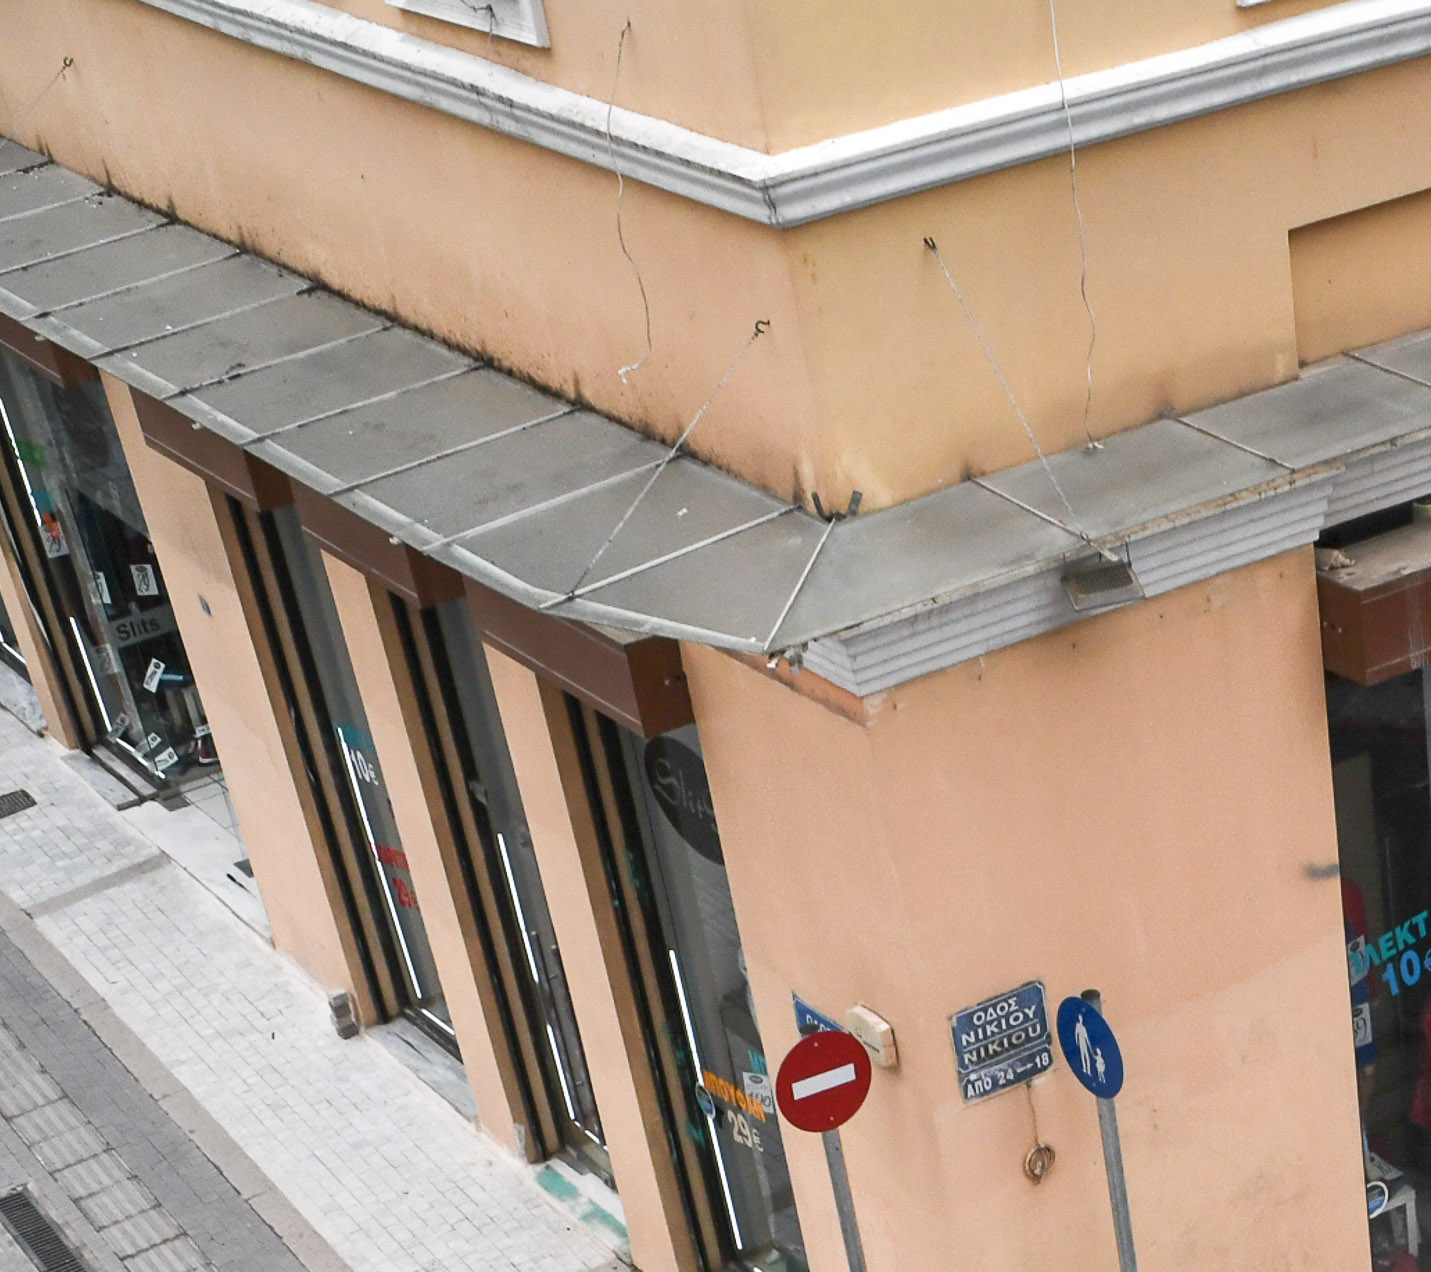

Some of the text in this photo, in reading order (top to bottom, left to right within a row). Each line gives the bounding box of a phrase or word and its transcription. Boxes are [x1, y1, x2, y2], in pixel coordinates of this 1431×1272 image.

[116, 617, 161, 641] Slits
[961, 1004, 1036, 1046] ΝΙΚΙΟΥ
[973, 996, 1019, 1025] ΟΔΟΣ
[964, 1023, 1041, 1064] NIKIOU
[967, 1052, 1049, 1098] ΑΠΟ 24 18
[728, 1110, 764, 1152] 29€
